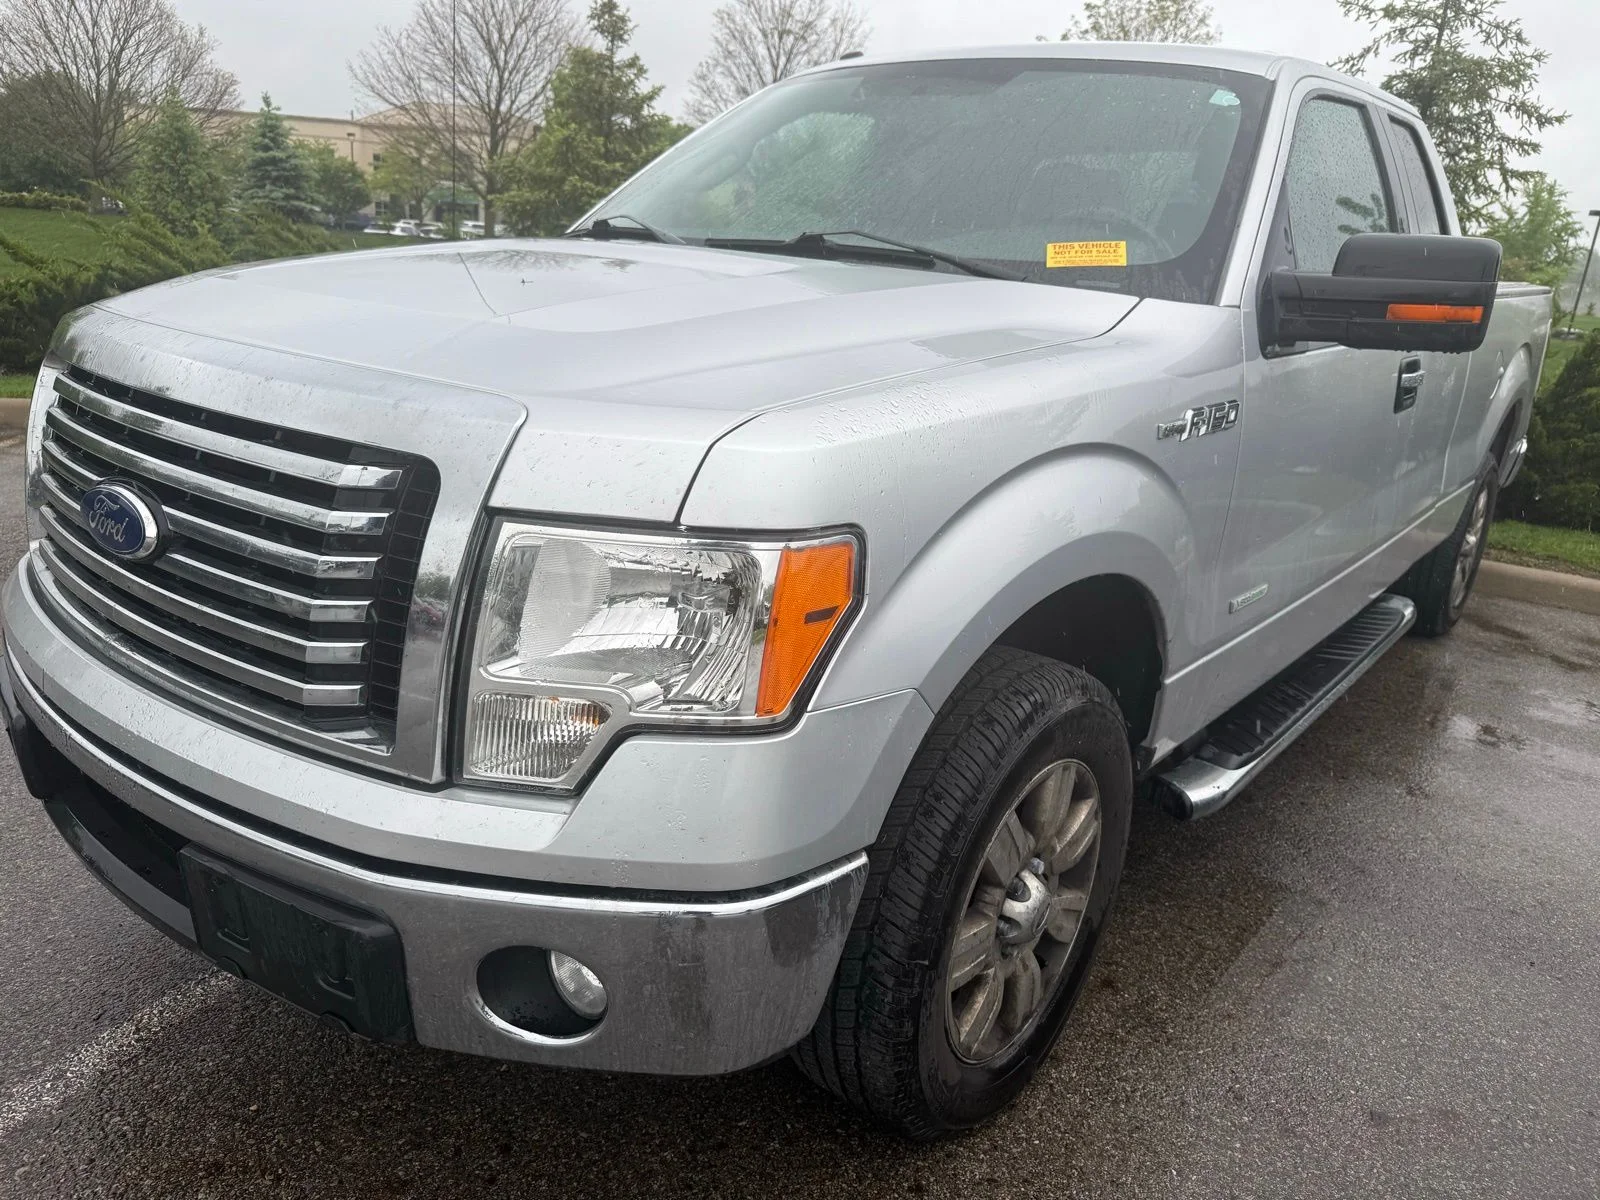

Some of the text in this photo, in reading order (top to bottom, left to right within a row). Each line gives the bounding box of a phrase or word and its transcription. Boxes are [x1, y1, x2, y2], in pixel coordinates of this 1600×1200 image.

[1052, 242, 1121, 251] THIS VEHICLE
[89, 494, 129, 543] Ford
